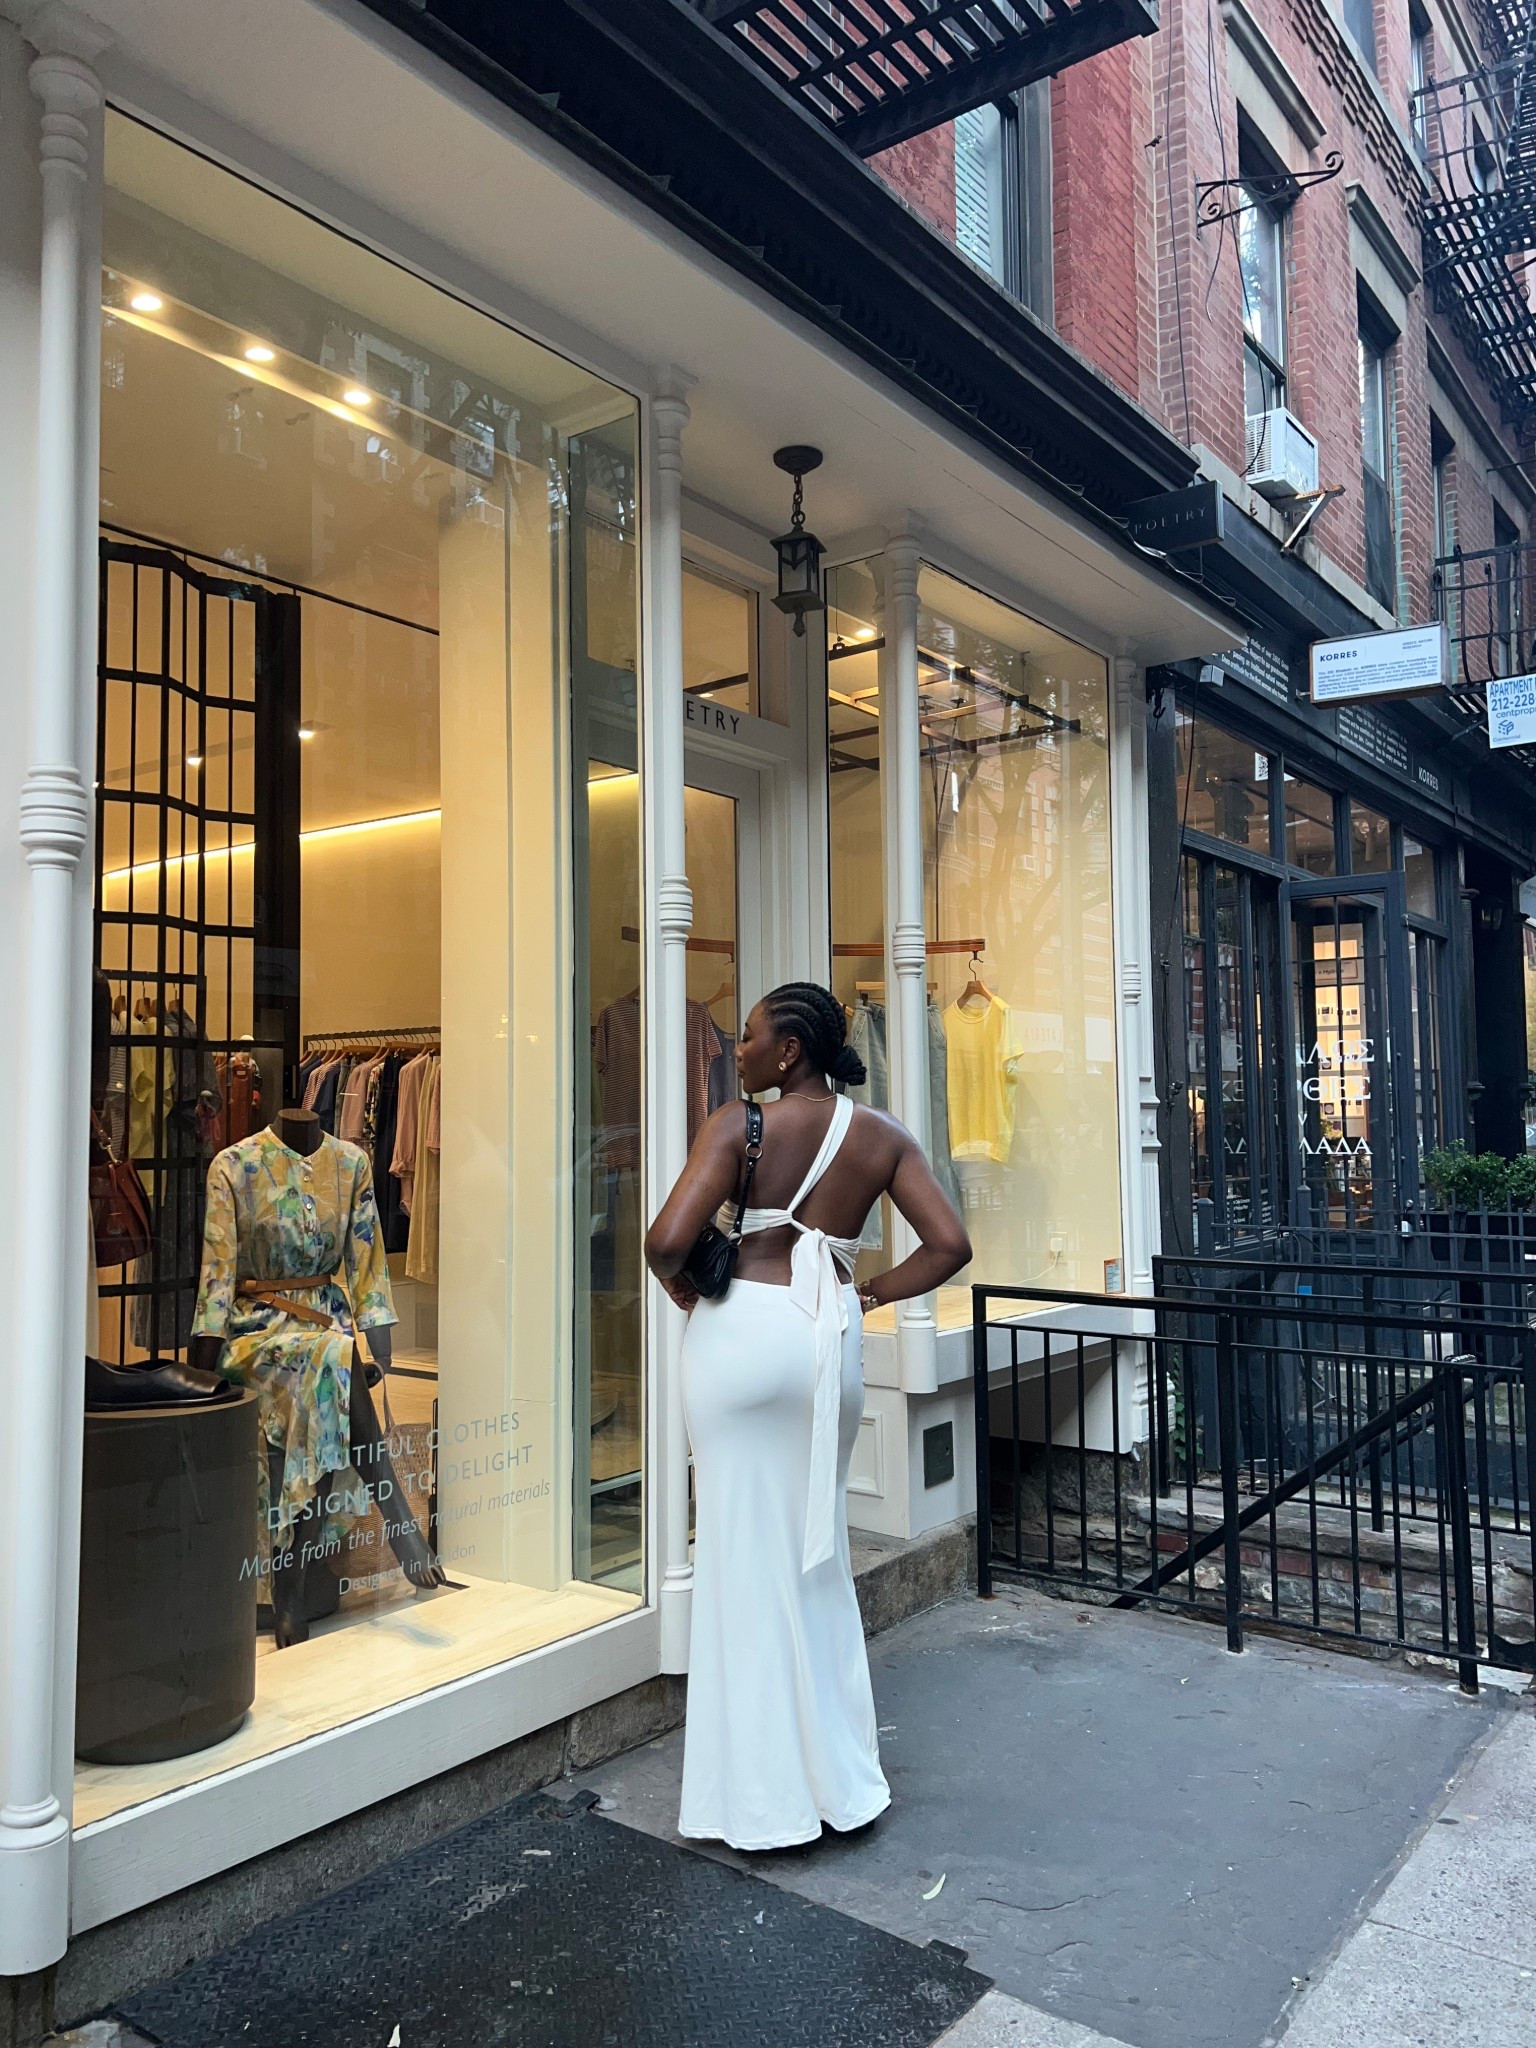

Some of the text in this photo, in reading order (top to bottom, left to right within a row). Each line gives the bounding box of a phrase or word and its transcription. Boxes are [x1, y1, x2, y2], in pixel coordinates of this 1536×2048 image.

[1320, 650, 1358, 662] KORRES
[1490, 678, 1533, 698] APARTMENT
[1491, 693, 1536, 711] 212-228
[1418, 766, 1439, 791] KORRES
[284, 1411, 520, 1483] BEAUTIFUL CLOTHES
[267, 1444, 534, 1529] DESIGNED TO DELIGHT
[238, 1478, 551, 1581] Made from the finest natural materials
[339, 1542, 476, 1595] Designed in London
